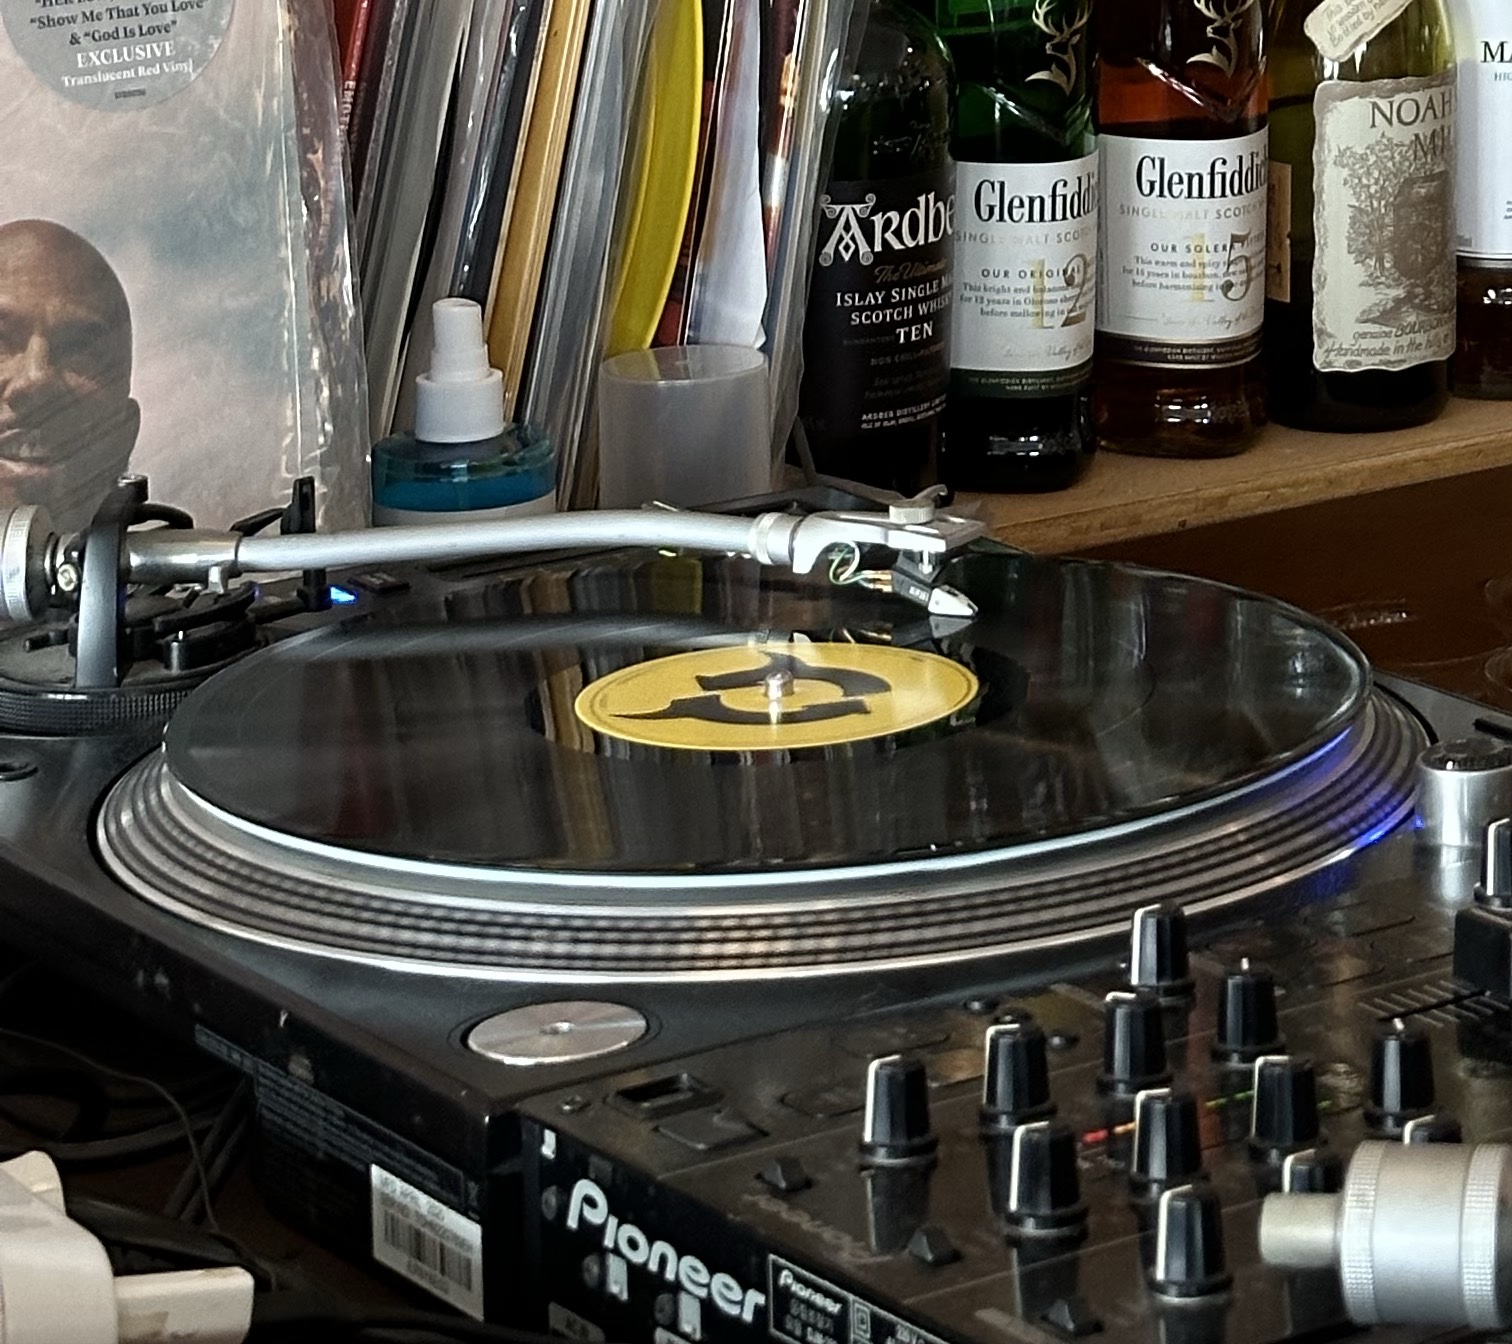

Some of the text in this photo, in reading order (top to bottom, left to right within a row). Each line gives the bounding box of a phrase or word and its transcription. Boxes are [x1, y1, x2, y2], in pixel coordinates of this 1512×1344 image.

[81, 10, 102, 24] Me
[106, 5, 139, 20] That
[142, 1, 168, 16] You
[69, 32, 81, 45] &
[123, 25, 135, 39] Is
[77, 40, 175, 68] EXCLUSIVE
[61, 58, 193, 87] Translucent Red Vinyl
[1151, 243, 1177, 253] OUR
[981, 268, 1010, 279] OUR
[836, 282, 939, 307] ISLAY SINGLE
[850, 305, 913, 326] SCOTCH
[896, 322, 933, 343] TEN
[566, 1178, 767, 1324] Pioneer
